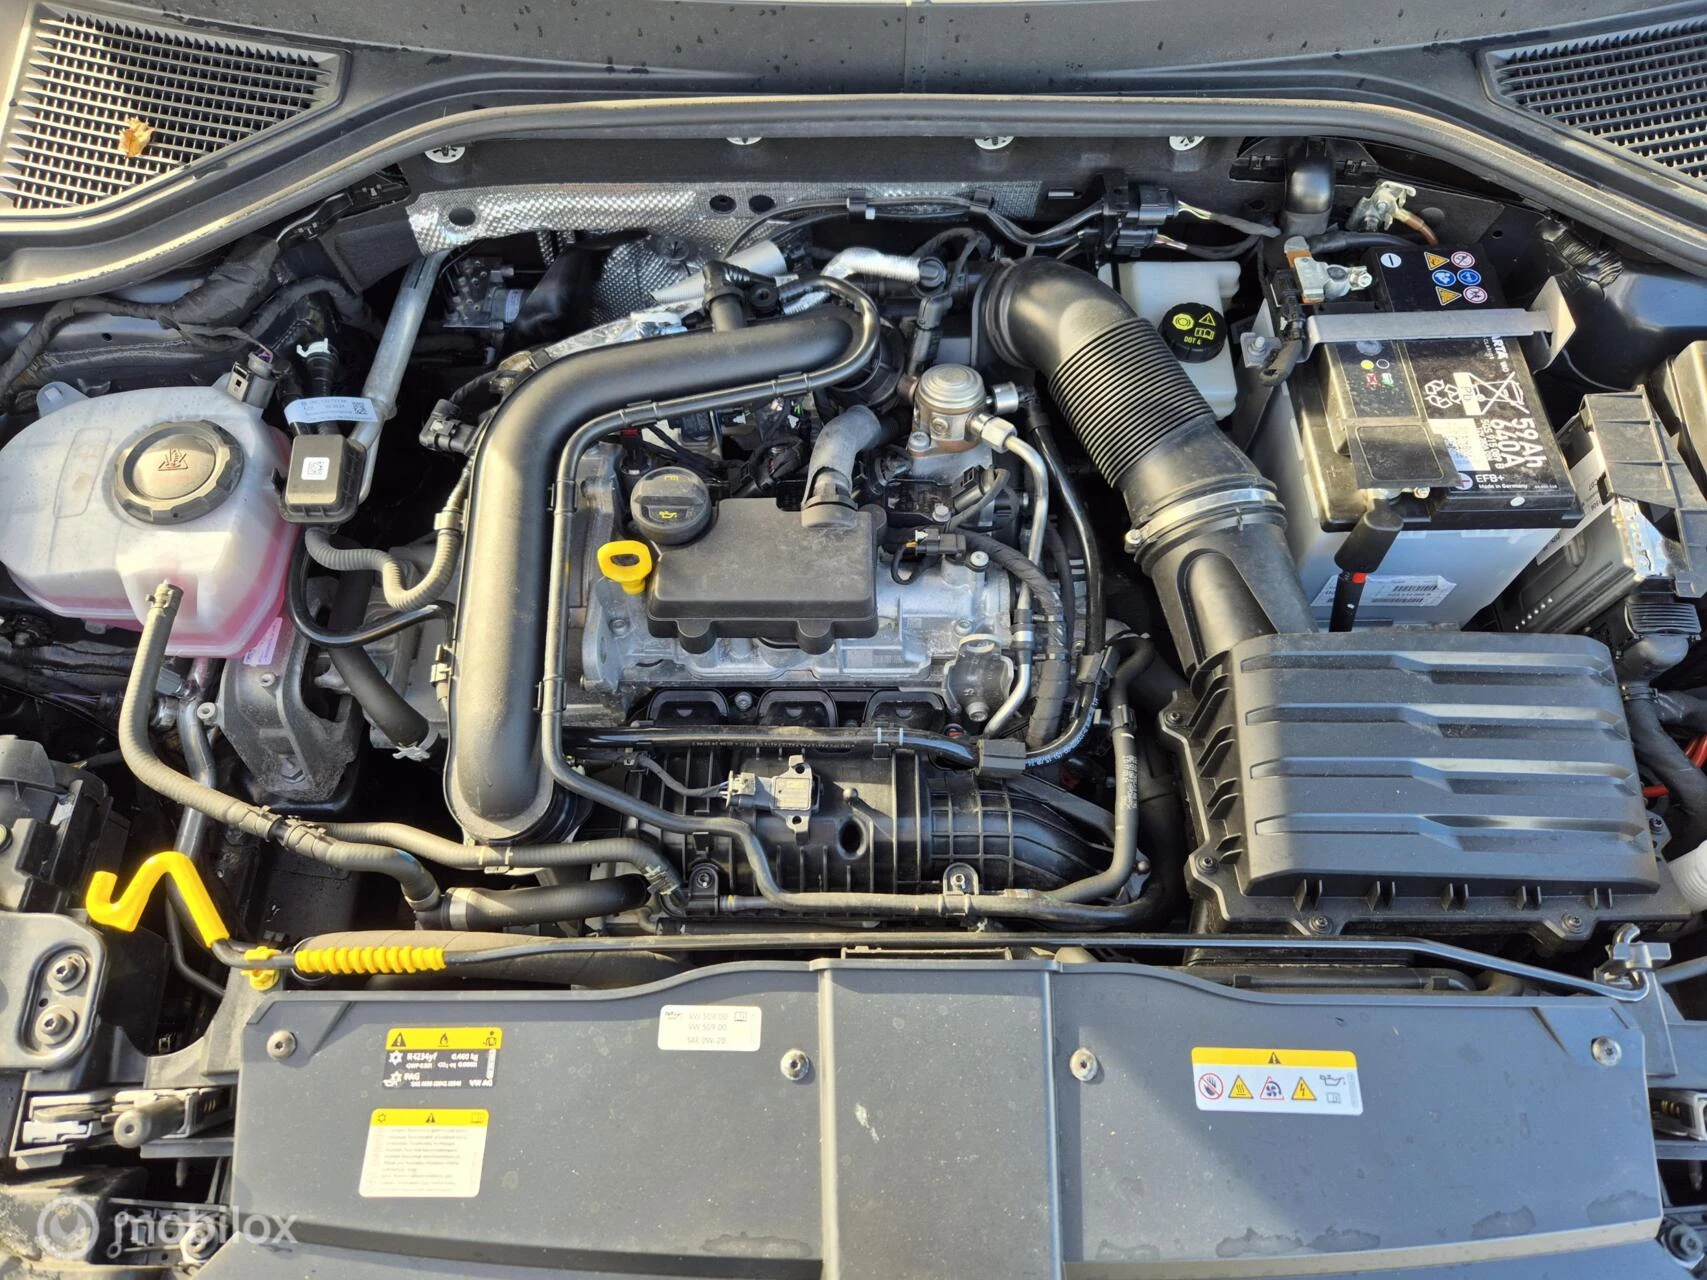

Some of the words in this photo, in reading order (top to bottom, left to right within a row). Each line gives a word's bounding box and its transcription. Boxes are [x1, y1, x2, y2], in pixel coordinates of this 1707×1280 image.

[1184, 336, 1196, 344] DOT
[1491, 336, 1509, 360] RTA
[1460, 386, 1474, 401] Pb
[1490, 419, 1525, 468] 640A
[1512, 418, 1548, 467] 59Ah
[1475, 474, 1505, 483] EFB+
[688, 1012, 701, 1020] VW
[688, 1023, 700, 1031] VW
